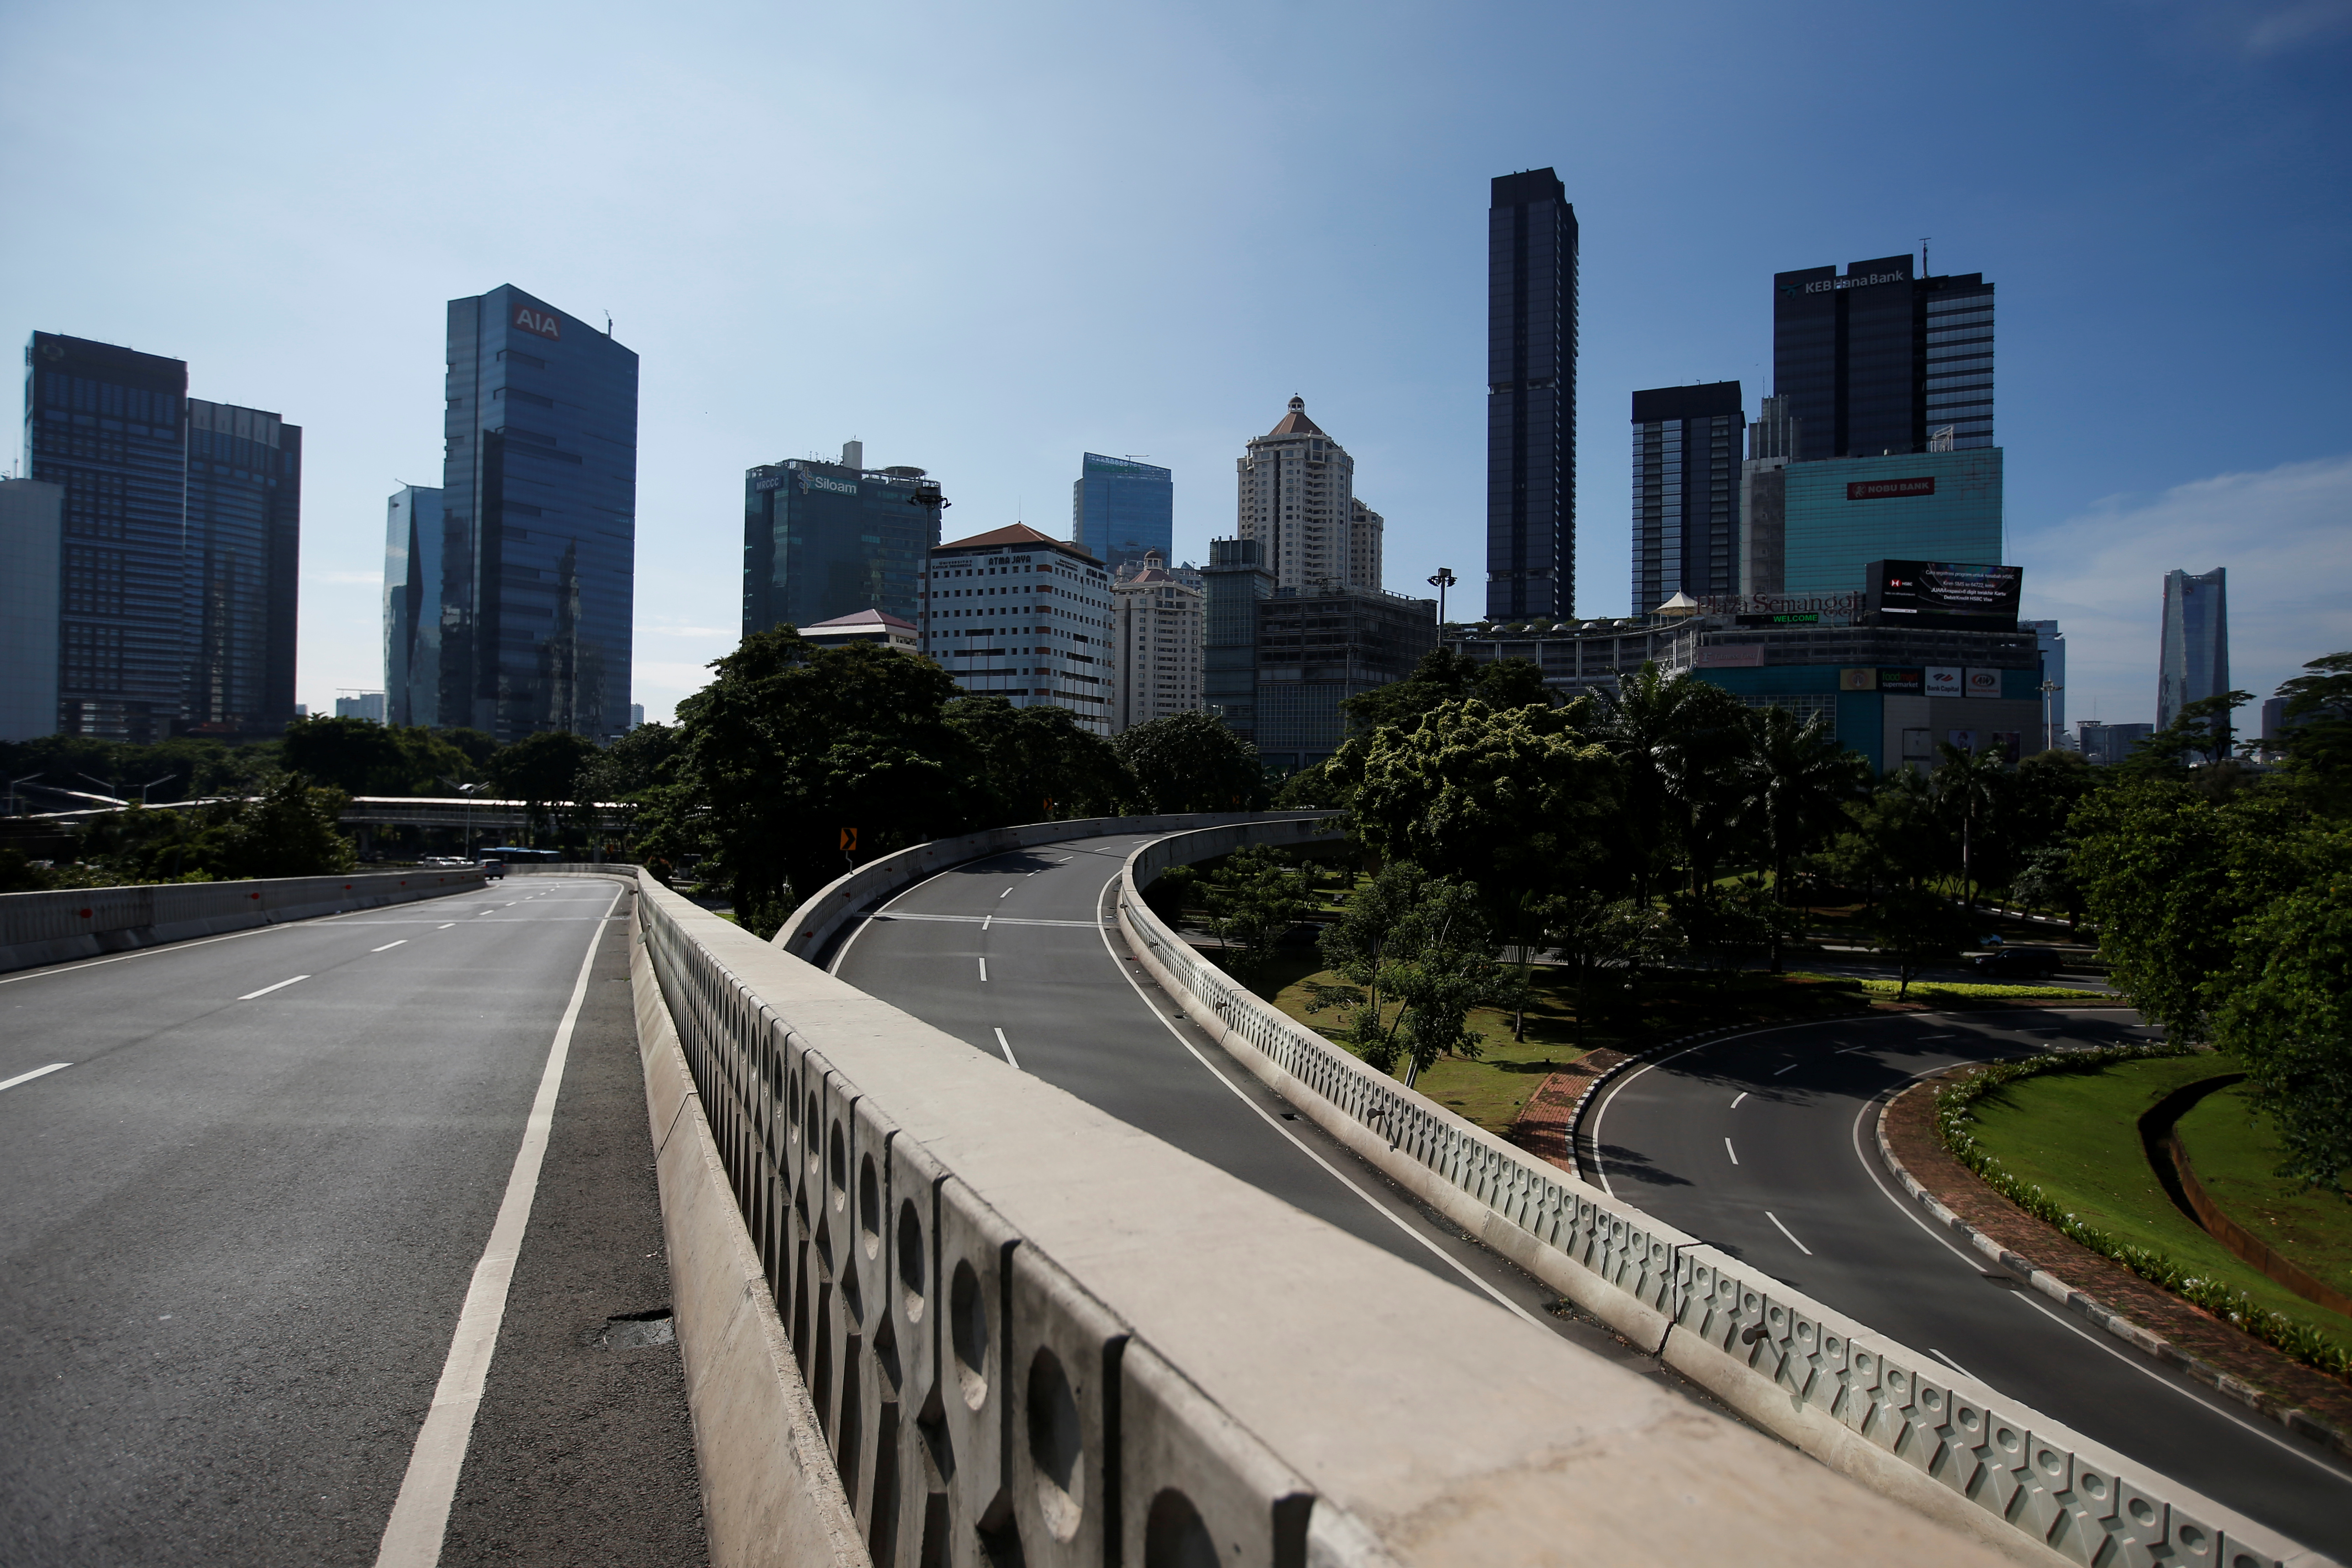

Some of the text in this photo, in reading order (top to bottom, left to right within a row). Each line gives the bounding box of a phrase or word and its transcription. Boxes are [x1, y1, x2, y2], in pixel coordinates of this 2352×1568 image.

[1806, 270, 1904, 293] KEB Hana Bank
[517, 309, 559, 337] AIA
[756, 478, 779, 491] MRCCC
[815, 477, 857, 494] Siloam
[1868, 482, 1929, 493] NOBU BANK
[988, 555, 1031, 565] ATMA JAYA
[1086, 568, 1097, 578] ATMA
[1696, 591, 1858, 618] Plaza Semanggi
[1773, 614, 1818, 623] WELCOME
